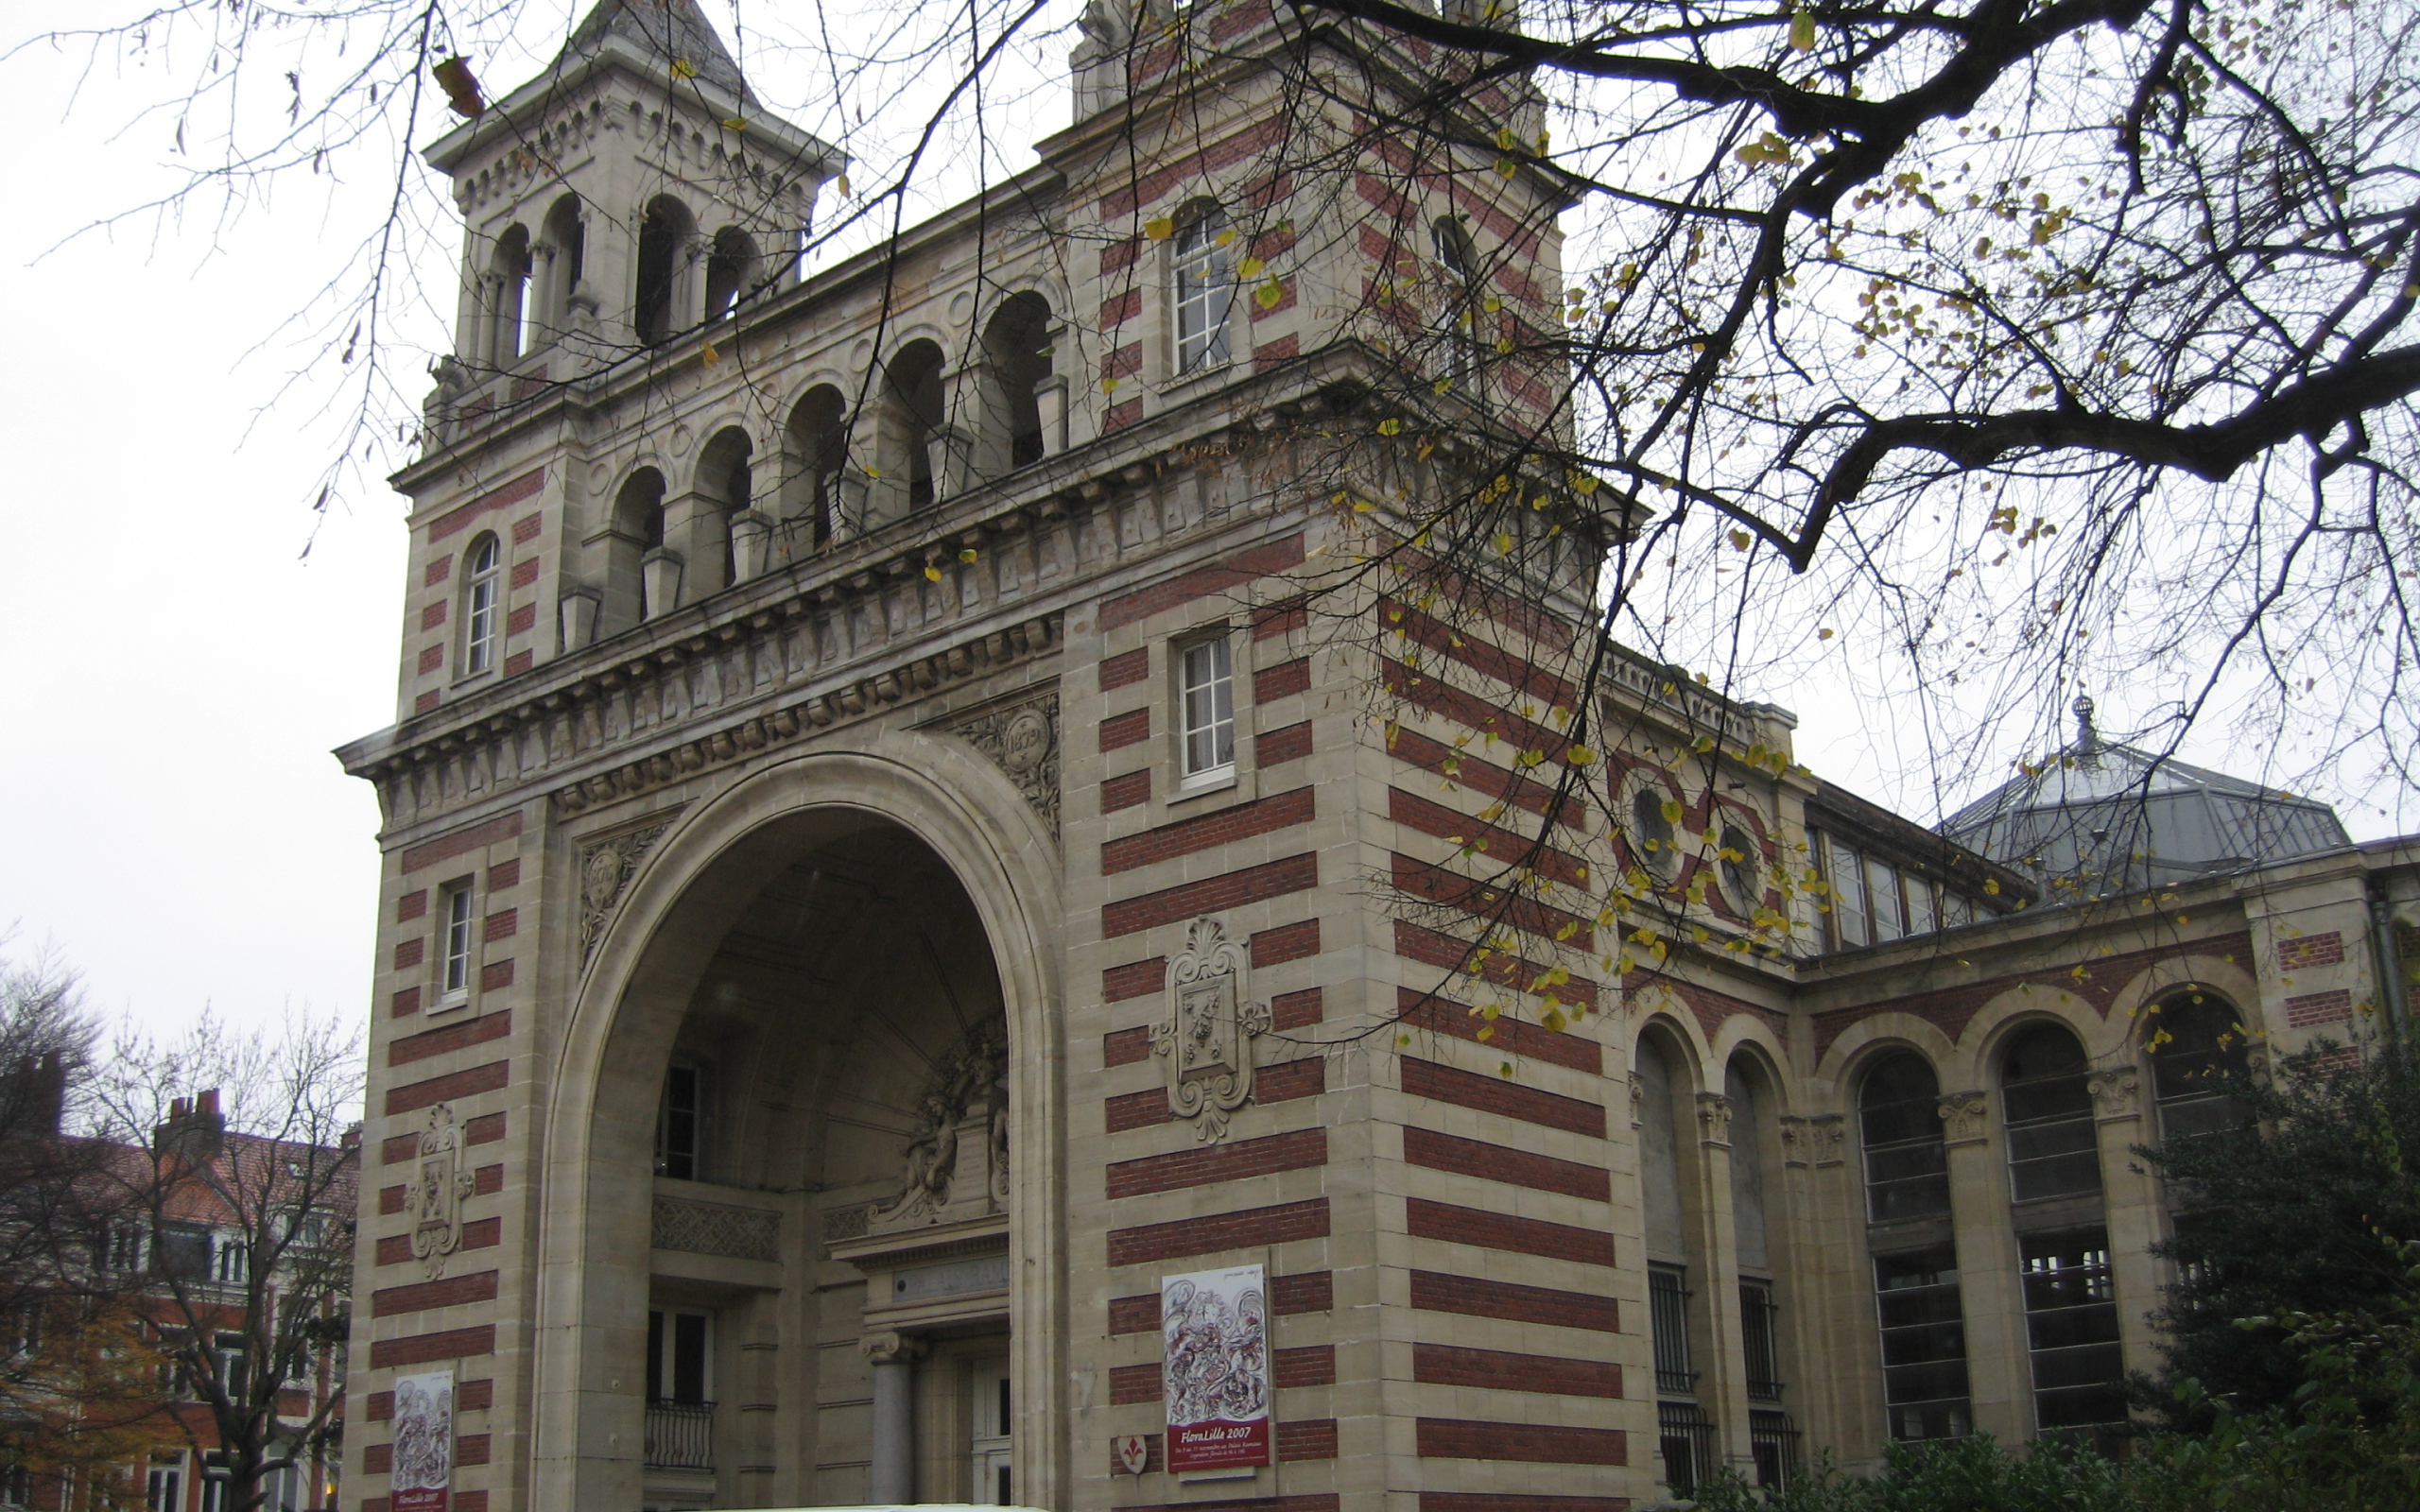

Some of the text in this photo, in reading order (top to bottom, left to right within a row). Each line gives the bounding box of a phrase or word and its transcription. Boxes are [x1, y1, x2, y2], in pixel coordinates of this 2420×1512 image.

[1007, 729, 1040, 754] 1879
[1181, 1427, 1252, 1443] FloraLille 2007
